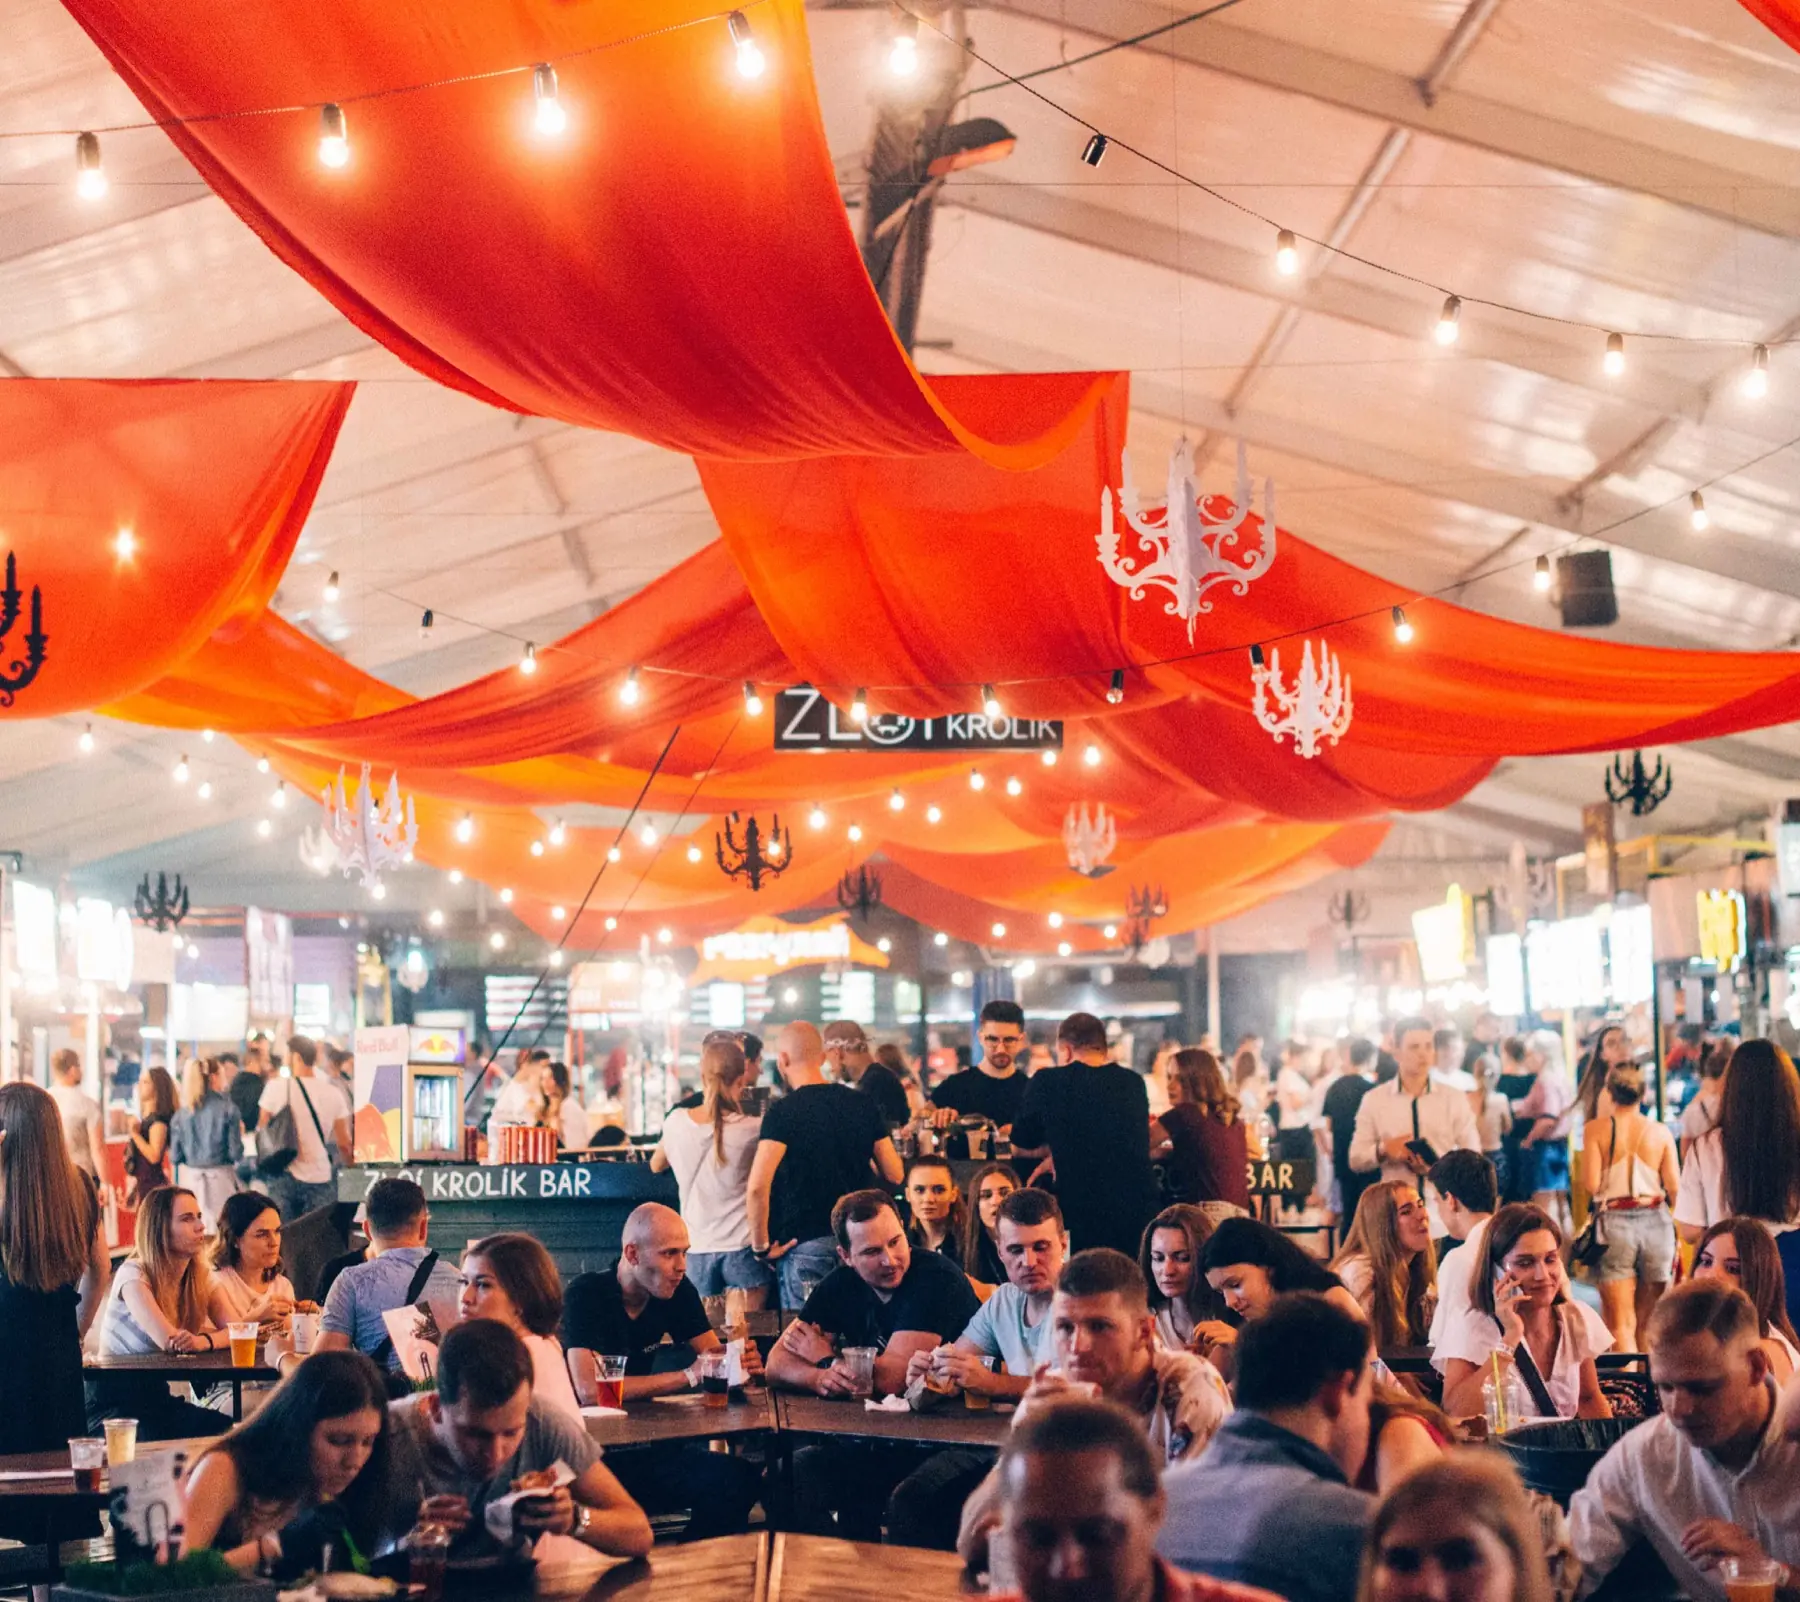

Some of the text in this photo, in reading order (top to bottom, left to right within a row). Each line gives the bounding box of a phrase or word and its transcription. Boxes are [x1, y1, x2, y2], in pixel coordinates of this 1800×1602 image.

[946, 714, 1057, 740] KROLIK
[539, 1167, 592, 1197] BAR
[1245, 1162, 1294, 1190] BAR
